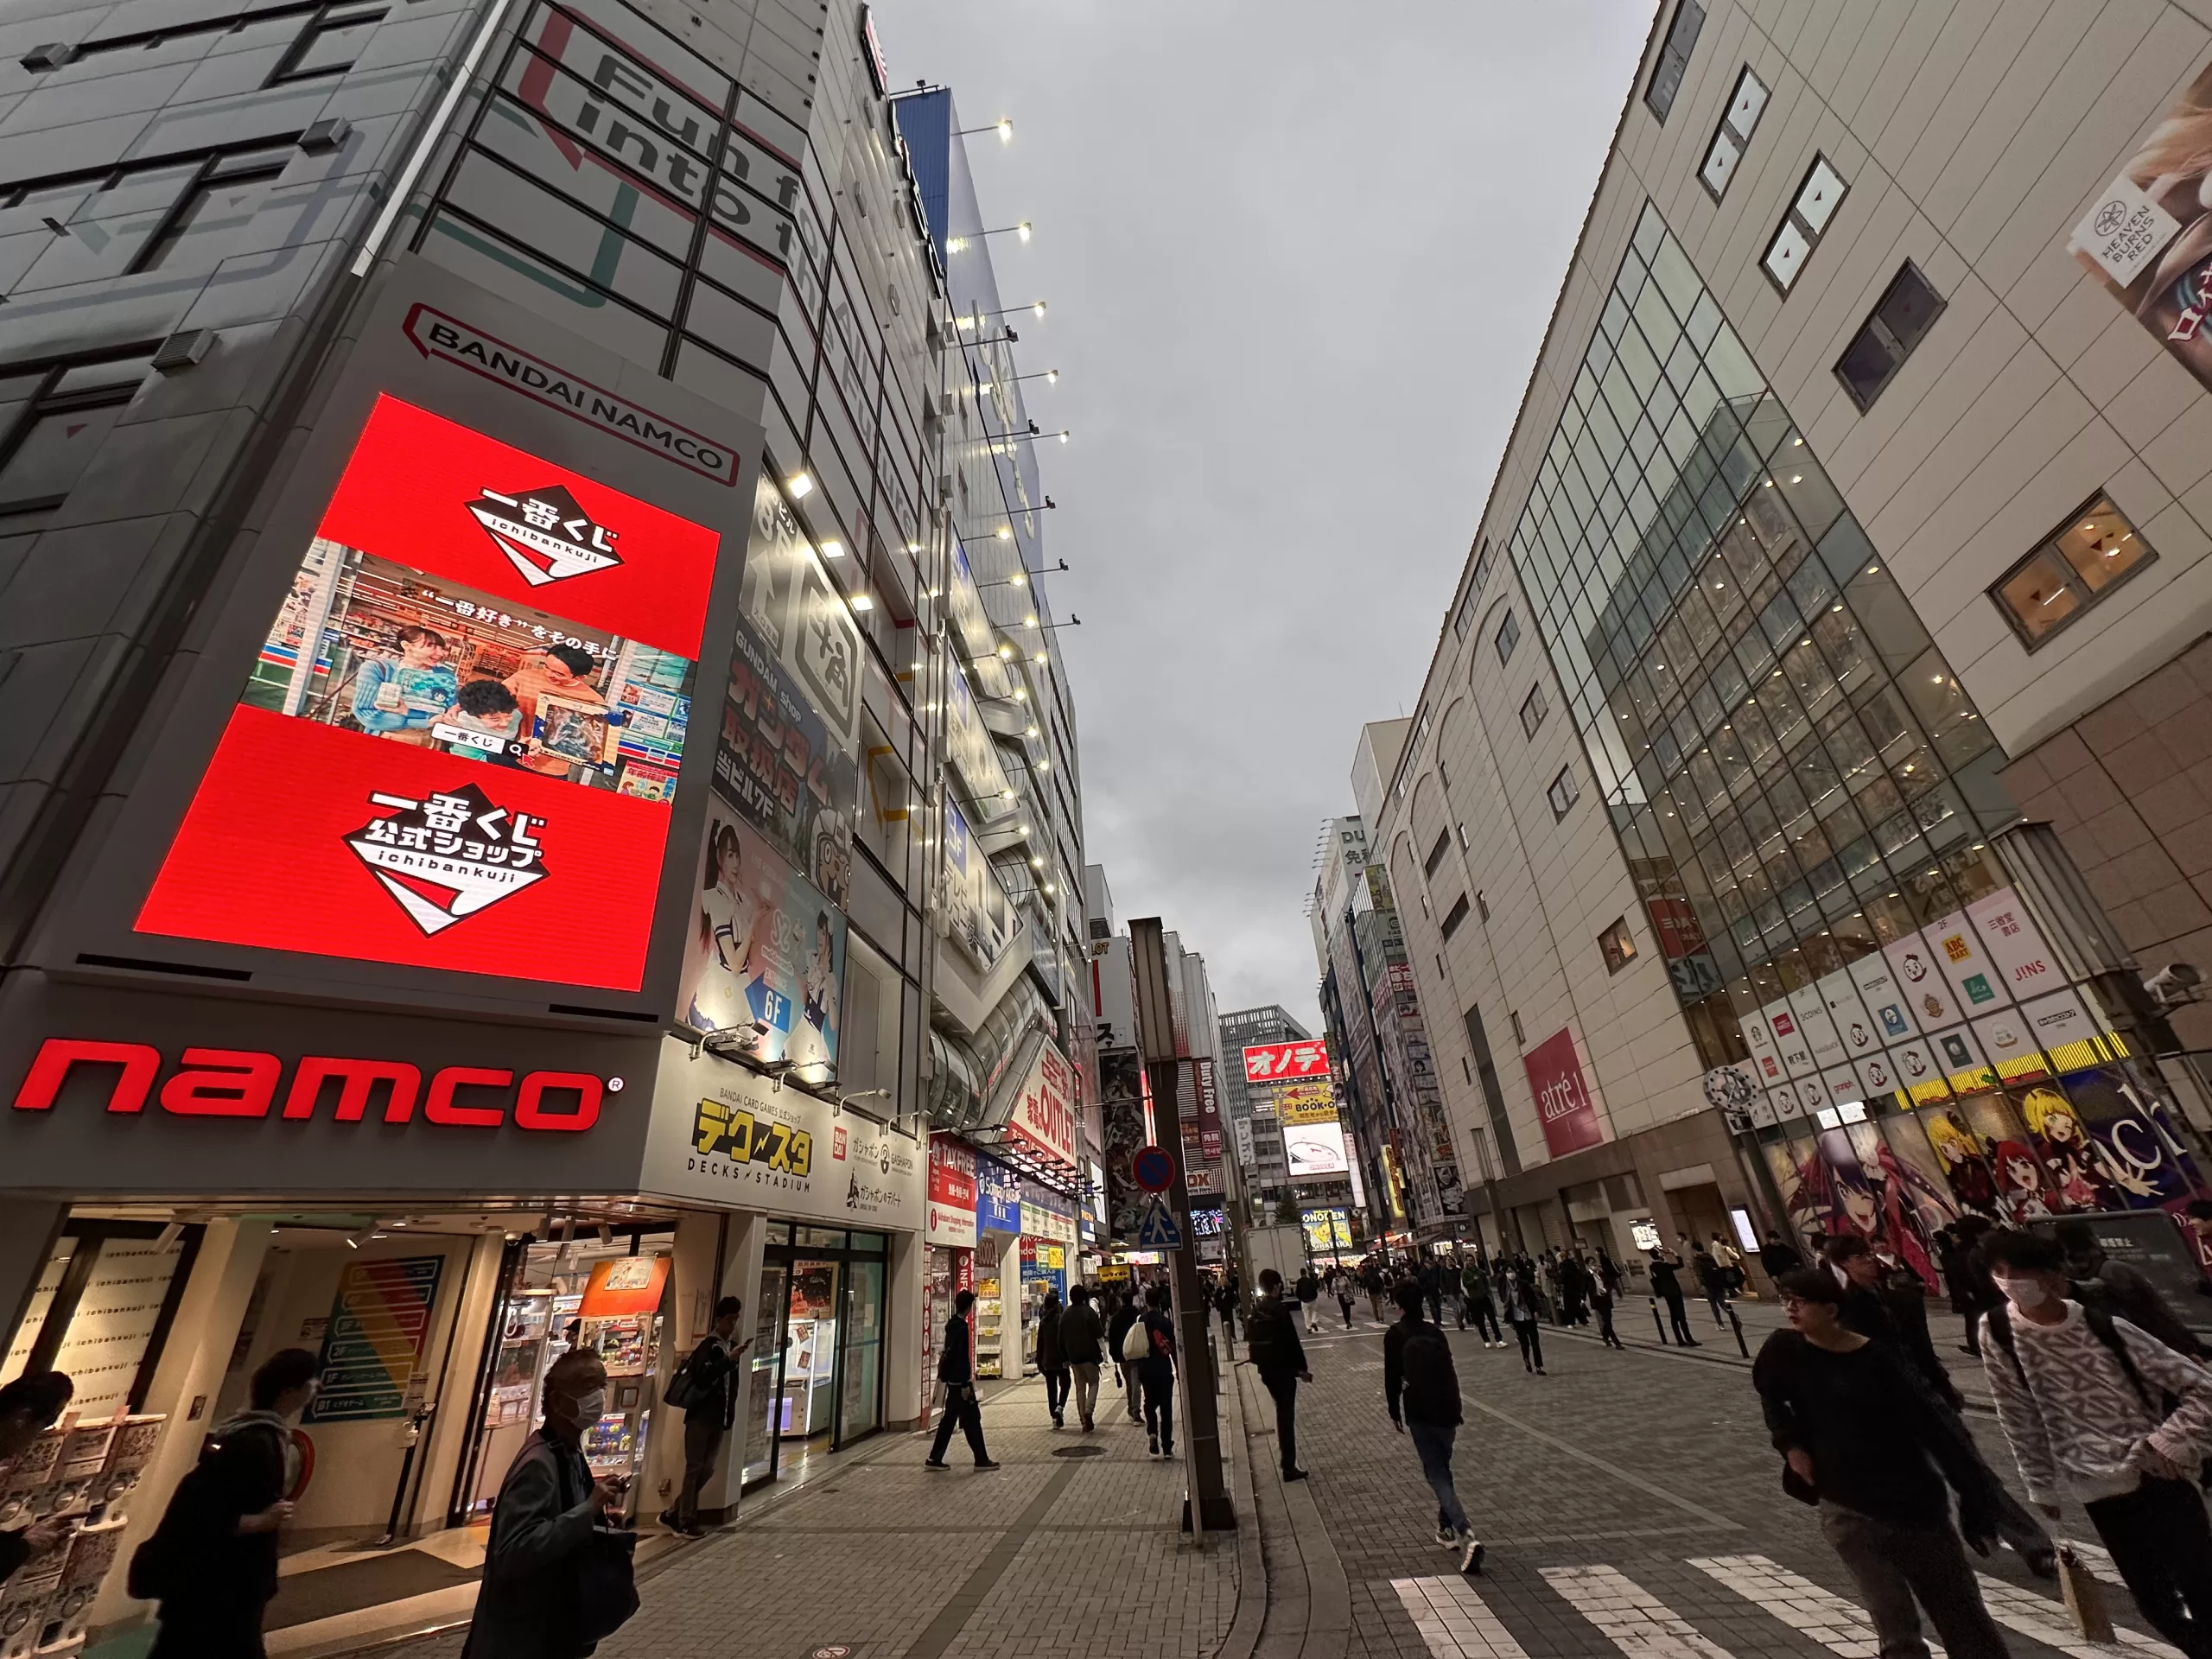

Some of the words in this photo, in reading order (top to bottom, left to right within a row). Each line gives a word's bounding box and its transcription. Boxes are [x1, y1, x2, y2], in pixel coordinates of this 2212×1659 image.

[594, 54, 751, 181] Fun
[576, 92, 751, 226] into
[2102, 205, 2150, 260] HEAVEN
[2112, 217, 2155, 264] BURNS
[2127, 232, 2153, 263] RED
[429, 321, 587, 410] BANDAI
[590, 391, 724, 474] NAMCO
[480, 488, 620, 554] 一番くじ
[758, 497, 792, 558] 8F
[490, 518, 600, 566] ichibankuji
[736, 629, 777, 693] GUNDAM
[779, 690, 802, 722] shop
[445, 730, 494, 748] 一番くじ
[728, 660, 827, 805] ガンダム
[626, 768, 666, 783] 年齢確認
[722, 705, 799, 817] 取扱店
[716, 749, 774, 818] 当ビル7F
[370, 790, 546, 849] 一番くじ
[366, 818, 542, 869] 公式ショップ
[378, 849, 517, 885] ichibankuji
[1937, 919, 1948, 931] 2F
[1987, 912, 2015, 931] 三省堂
[2001, 923, 2020, 937] 書店
[1091, 942, 1109, 955] LOT
[1945, 937, 1965, 953] ABC
[1948, 947, 1970, 961] MART
[765, 990, 782, 1024] 6F
[1200, 1062, 1213, 1087] Duty
[1247, 1041, 1331, 1076] オノデ
[10, 1037, 605, 1133] namco
[1203, 1089, 1216, 1113] Free
[1541, 1071, 1576, 1119] atré
[720, 1088, 742, 1105] BANDAI
[744, 1096, 759, 1110] CARD
[760, 1102, 778, 1117] GAMES
[835, 1131, 846, 1145] BAN
[1041, 1084, 1073, 1158] OUTLET
[834, 1143, 843, 1156] DAI
[853, 1137, 880, 1159] ガシャポン
[943, 1143, 957, 1171] TAX
[957, 1151, 975, 1177] FREE
[688, 1158, 740, 1179] DECKS
[756, 1172, 810, 1193] STADIUM
[861, 1185, 901, 1208] ガシャポンのデパート
[96, 1275, 154, 1287] ichibankuji
[86, 1305, 145, 1317] ichibankuji
[77, 1333, 137, 1346] ichibankuji
[68, 1391, 119, 1407] hibankuji
